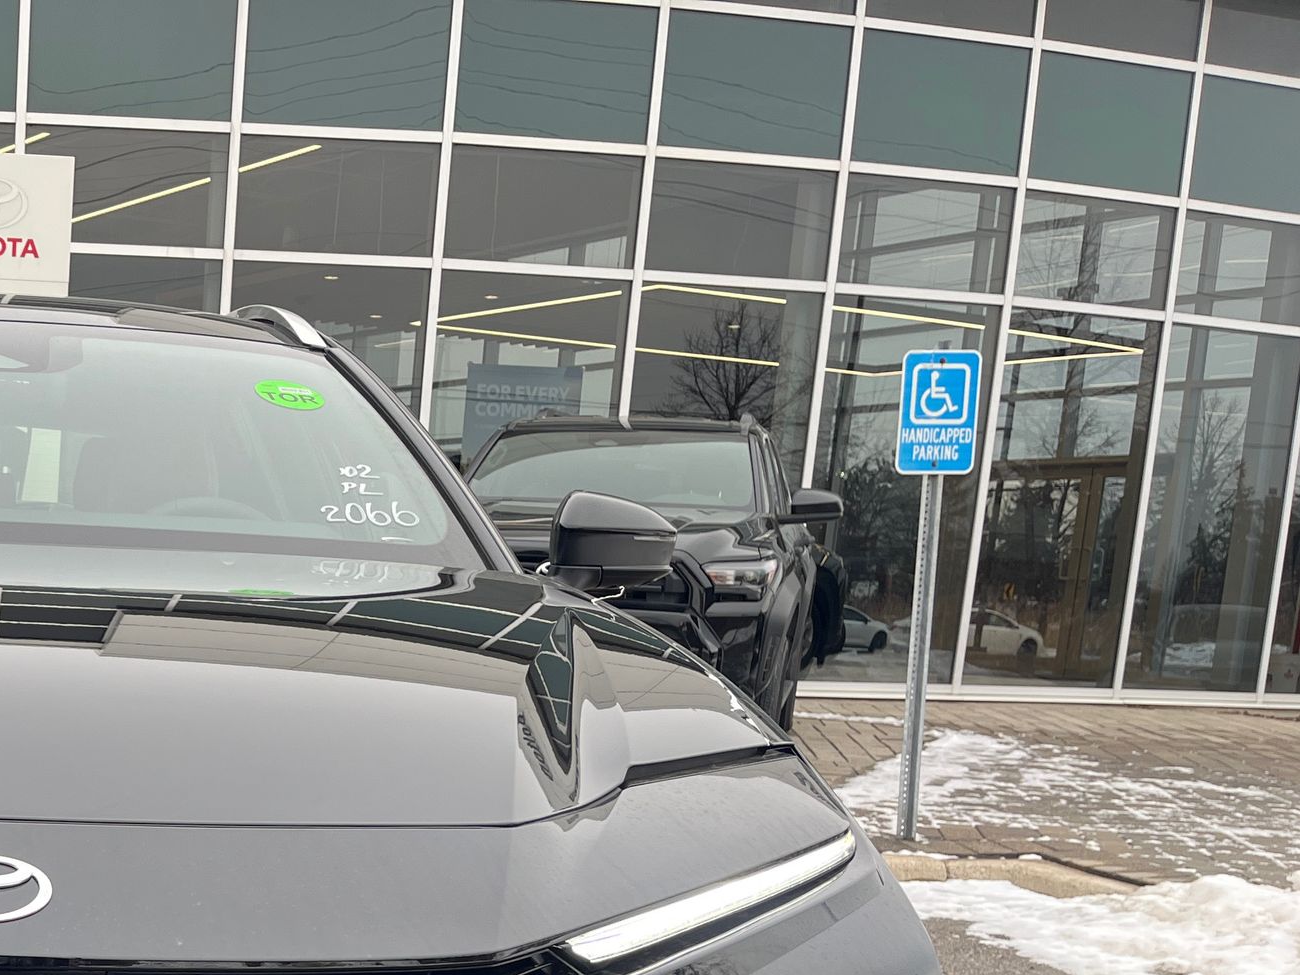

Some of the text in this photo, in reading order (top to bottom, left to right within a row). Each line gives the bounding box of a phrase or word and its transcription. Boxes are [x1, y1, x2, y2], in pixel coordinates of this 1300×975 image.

[261, 391, 320, 405] TOR
[476, 383, 570, 402] FOR EVERY
[901, 428, 972, 444] HANDICAPPED
[912, 445, 959, 460] PARKING
[341, 482, 384, 496] PL
[320, 501, 420, 527] 2066
